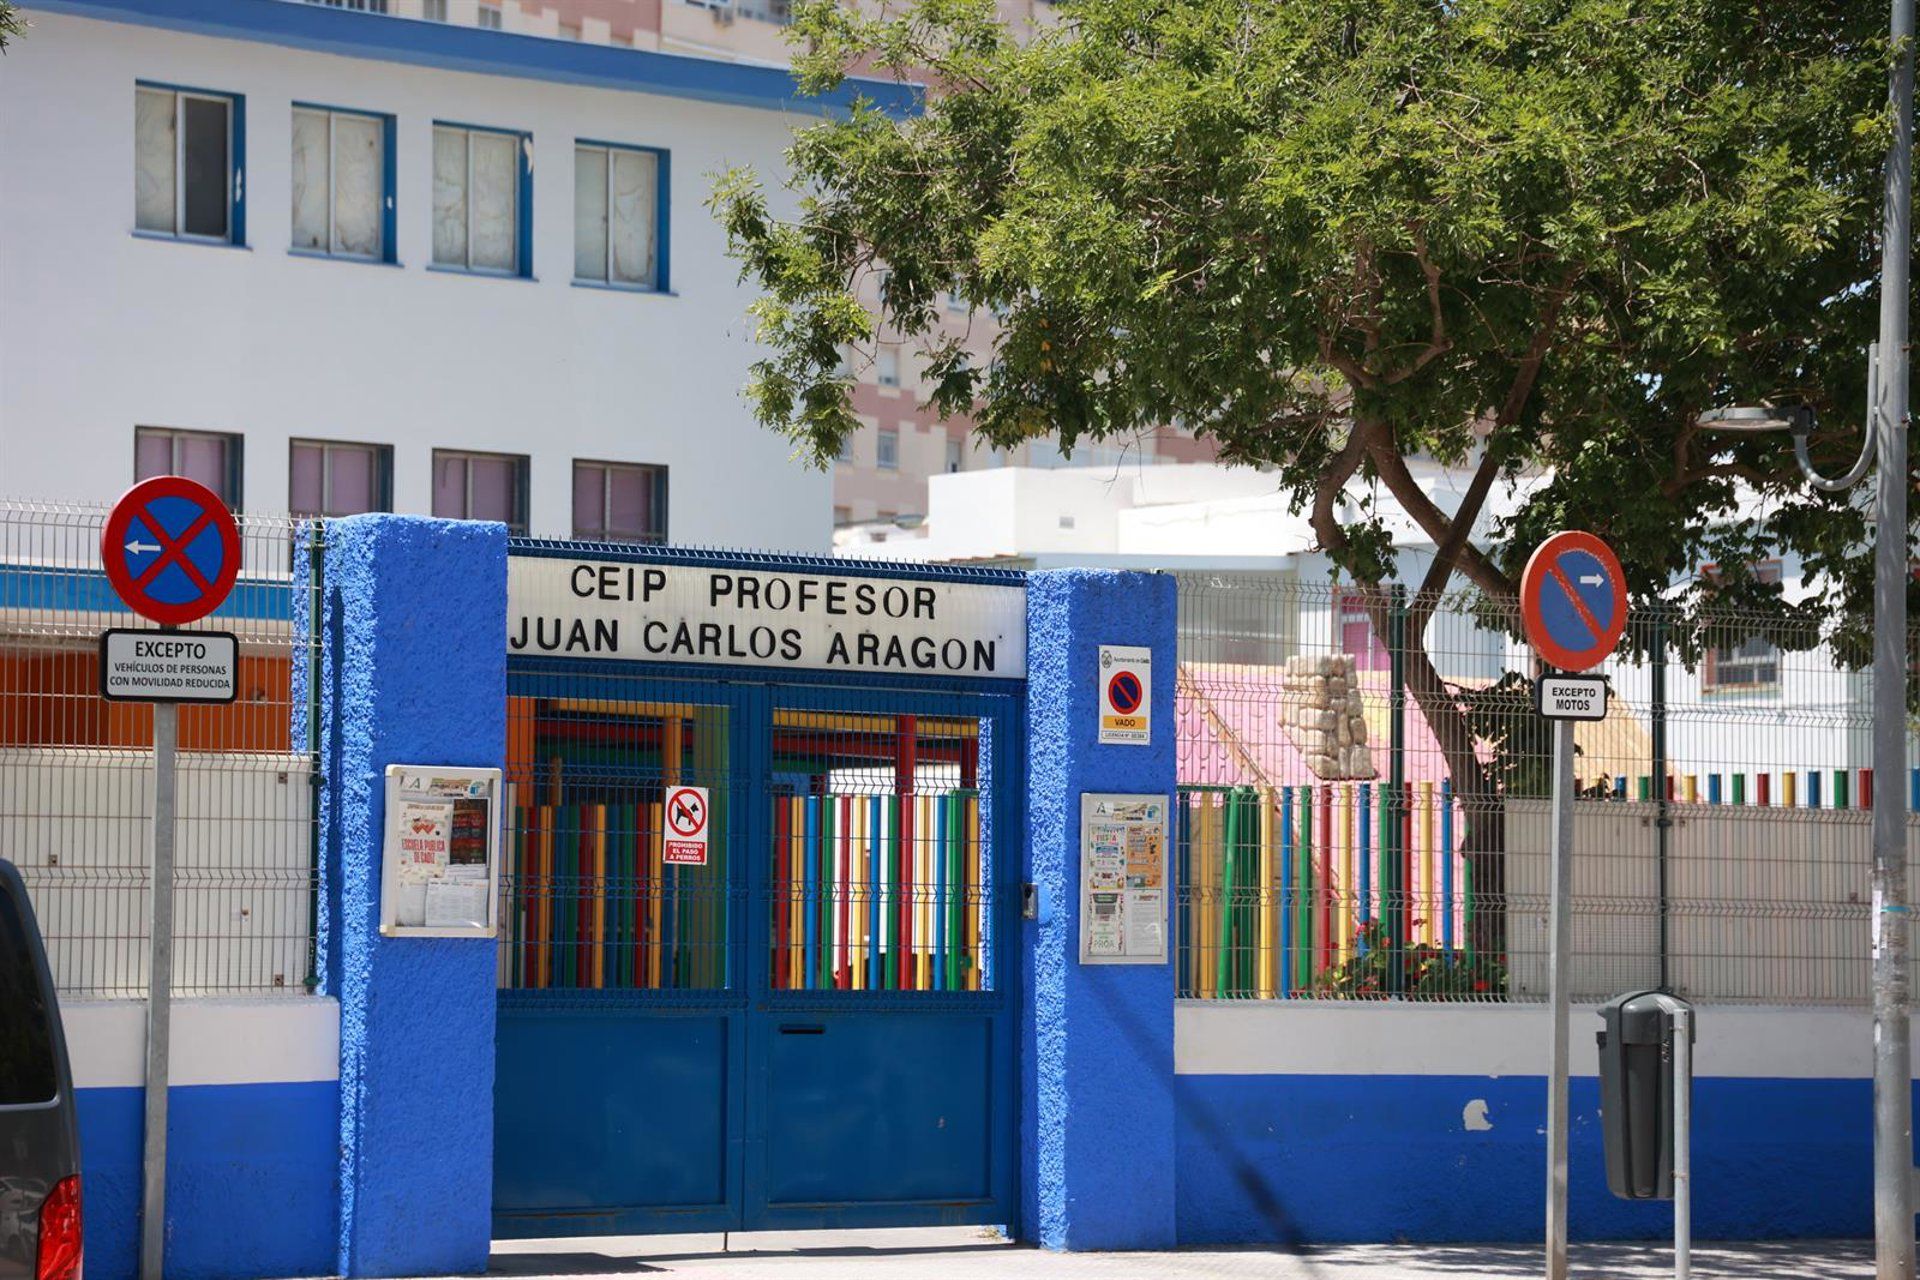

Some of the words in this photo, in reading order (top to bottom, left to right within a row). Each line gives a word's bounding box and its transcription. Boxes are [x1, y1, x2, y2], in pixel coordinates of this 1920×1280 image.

[570, 564, 667, 602] CEIP
[709, 573, 936, 619] PROFESOR
[135, 641, 206, 660] EXCEPTO
[509, 616, 618, 652] JUAN
[643, 620, 802, 661] CARLOS
[826, 631, 996, 672] ARAGON
[114, 661, 164, 674] VEHÍCULOS
[166, 664, 178, 674] DE
[180, 664, 227, 675] PERSONAS
[109, 676, 130, 686] CON
[132, 677, 183, 687] MOVILIDAD
[185, 678, 231, 689] REDUCIDA
[1552, 687, 1596, 697] EXCEPTO
[1556, 699, 1590, 710] MOTOS
[1114, 718, 1136, 727] VADO
[668, 841, 703, 849] PROHIBIDO
